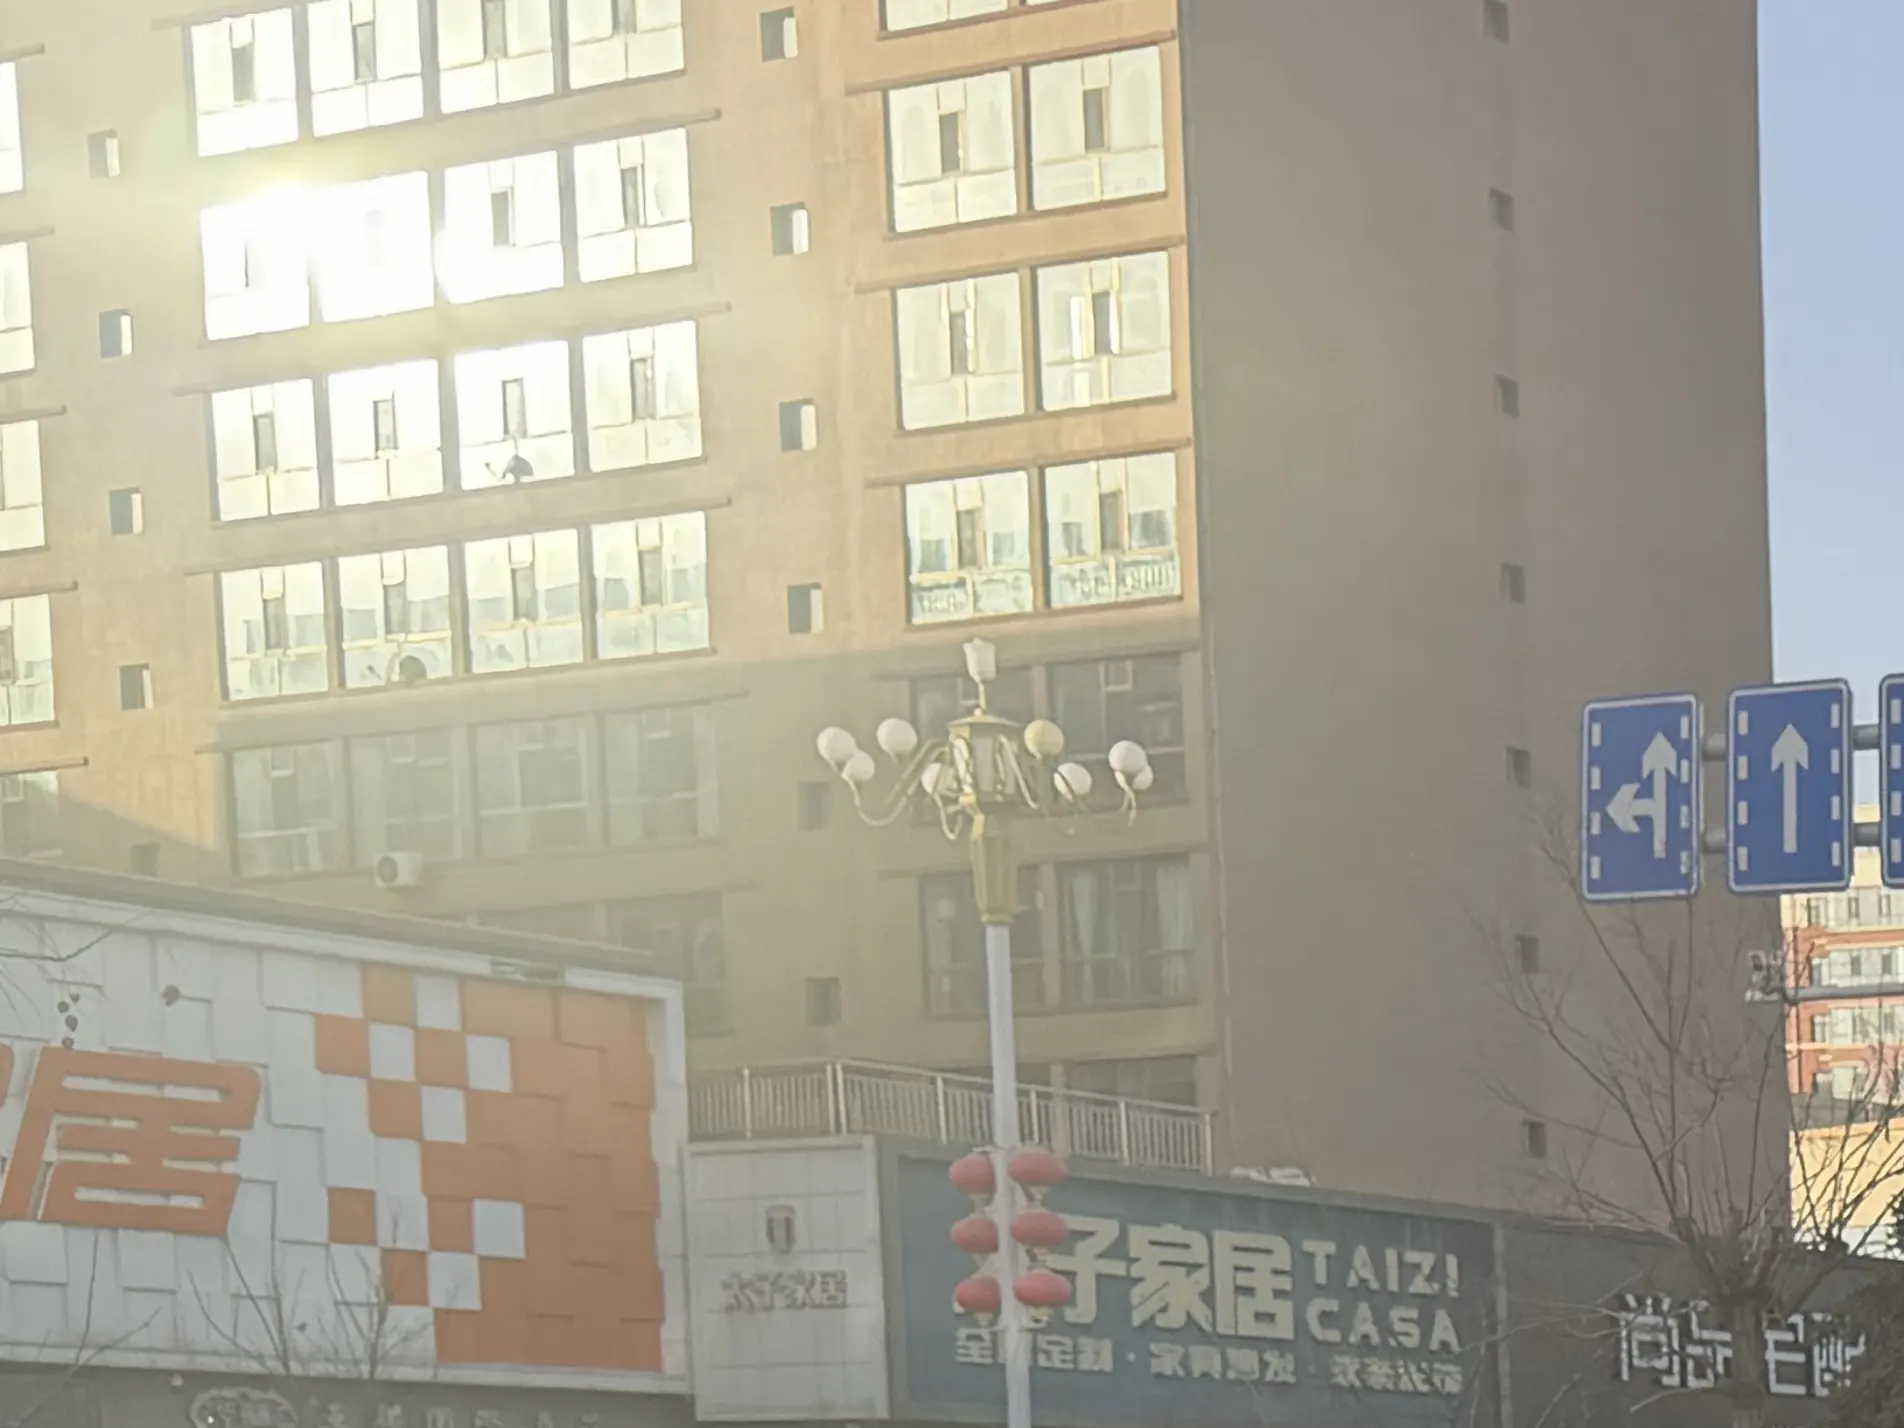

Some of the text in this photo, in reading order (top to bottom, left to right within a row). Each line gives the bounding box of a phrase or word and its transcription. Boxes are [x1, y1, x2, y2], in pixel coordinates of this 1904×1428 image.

[0, 1043, 262, 1236] 居
[953, 1213, 1294, 1340] 子家居
[1302, 1239, 1459, 1298] TAIZI
[1306, 1297, 1460, 1353] CASA
